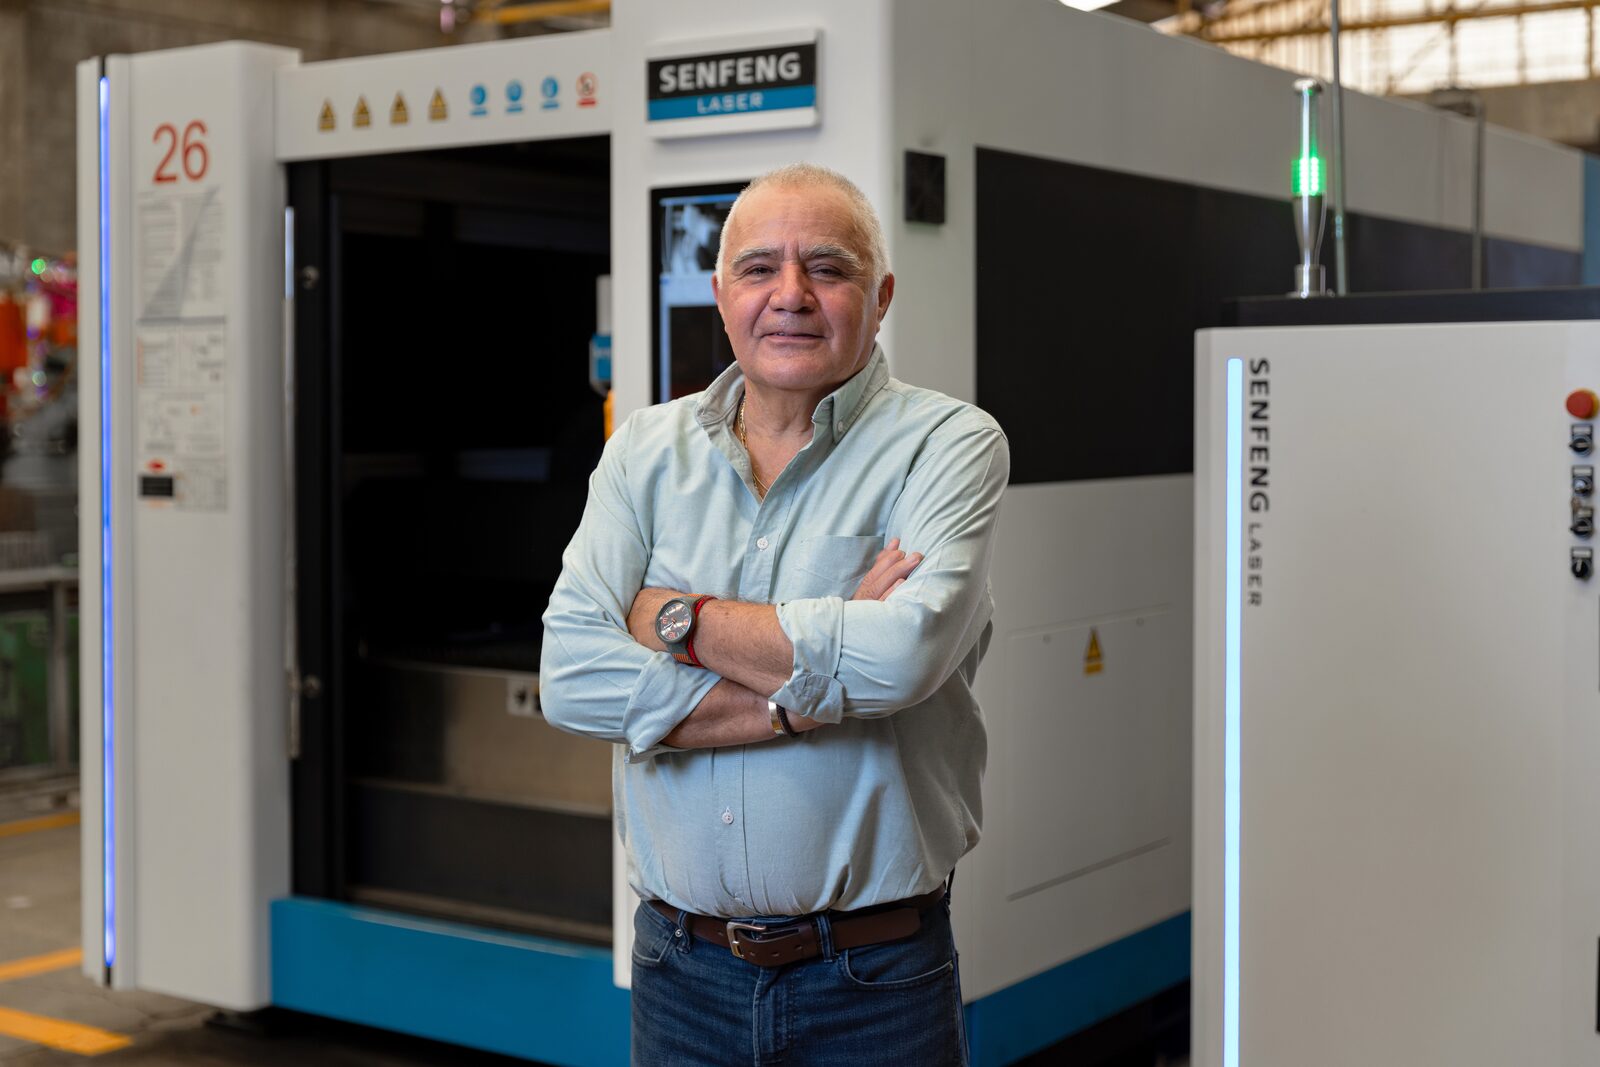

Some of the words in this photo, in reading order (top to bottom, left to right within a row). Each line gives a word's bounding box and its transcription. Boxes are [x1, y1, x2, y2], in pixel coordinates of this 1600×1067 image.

[658, 52, 802, 93] SENFENG
[697, 92, 764, 114] LASER
[153, 119, 210, 184] 26
[1249, 357, 1270, 513] SENFENG
[1248, 523, 1263, 606] LASER
